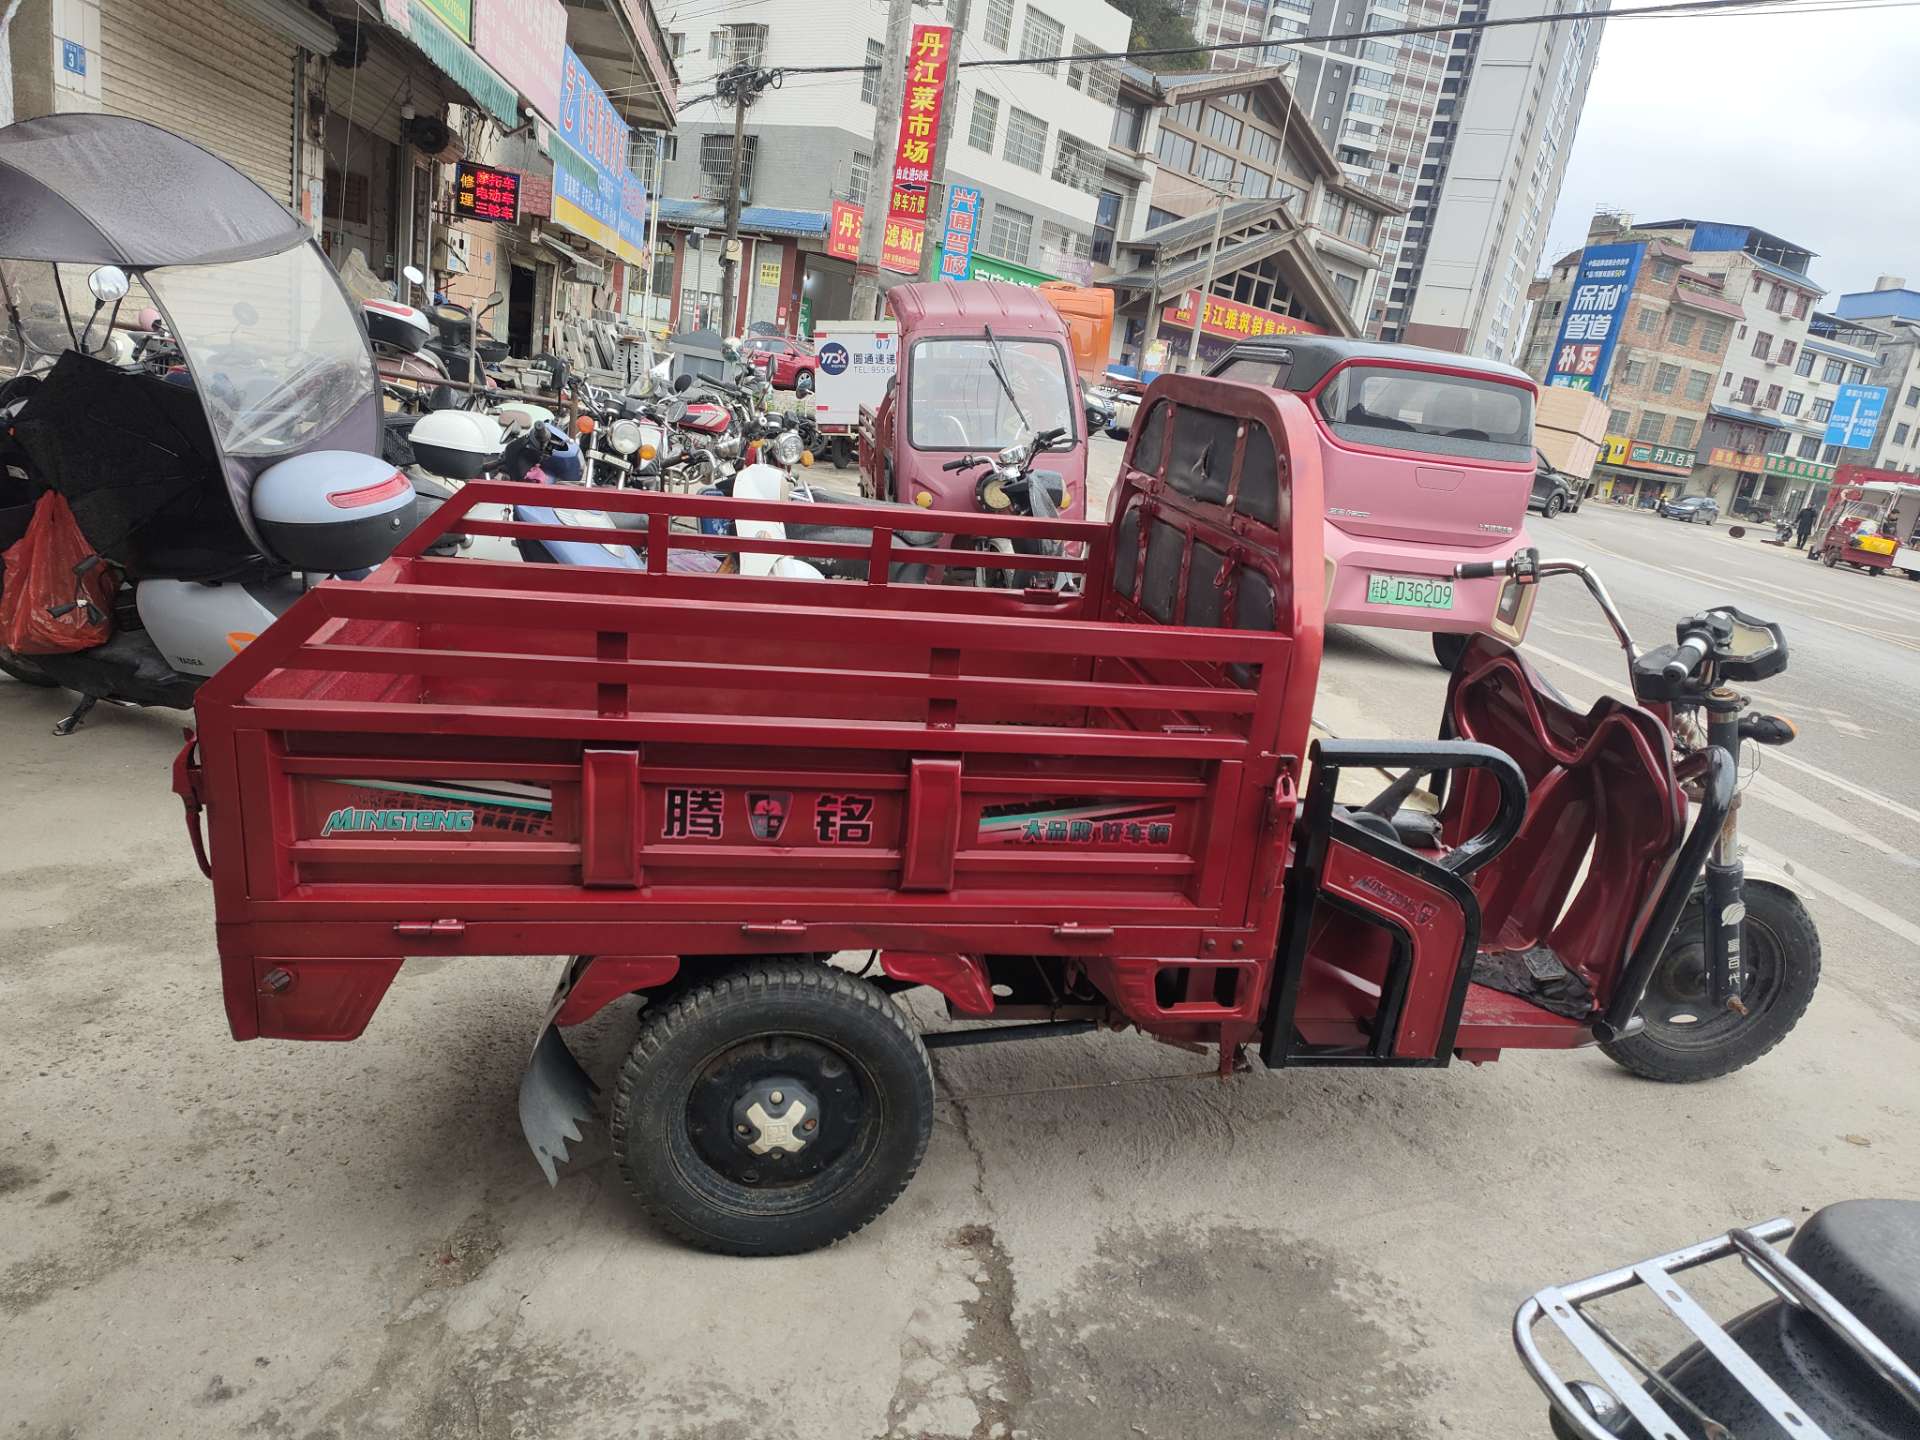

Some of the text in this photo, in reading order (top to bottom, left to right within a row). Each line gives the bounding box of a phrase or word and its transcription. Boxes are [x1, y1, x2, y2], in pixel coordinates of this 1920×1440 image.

[902, 32, 944, 164] 丹江菜市场
[460, 174, 475, 207] 修理
[476, 171, 515, 190] 摩托车
[475, 201, 513, 219] 三轮车
[893, 191, 926, 214] 停车方便
[1573, 283, 1623, 311] 保利
[1564, 314, 1612, 340] 管道
[1654, 447, 1696, 468] 丹江百货
[661, 788, 875, 843] 腾 铭
[1022, 820, 1094, 844] 大品牌
